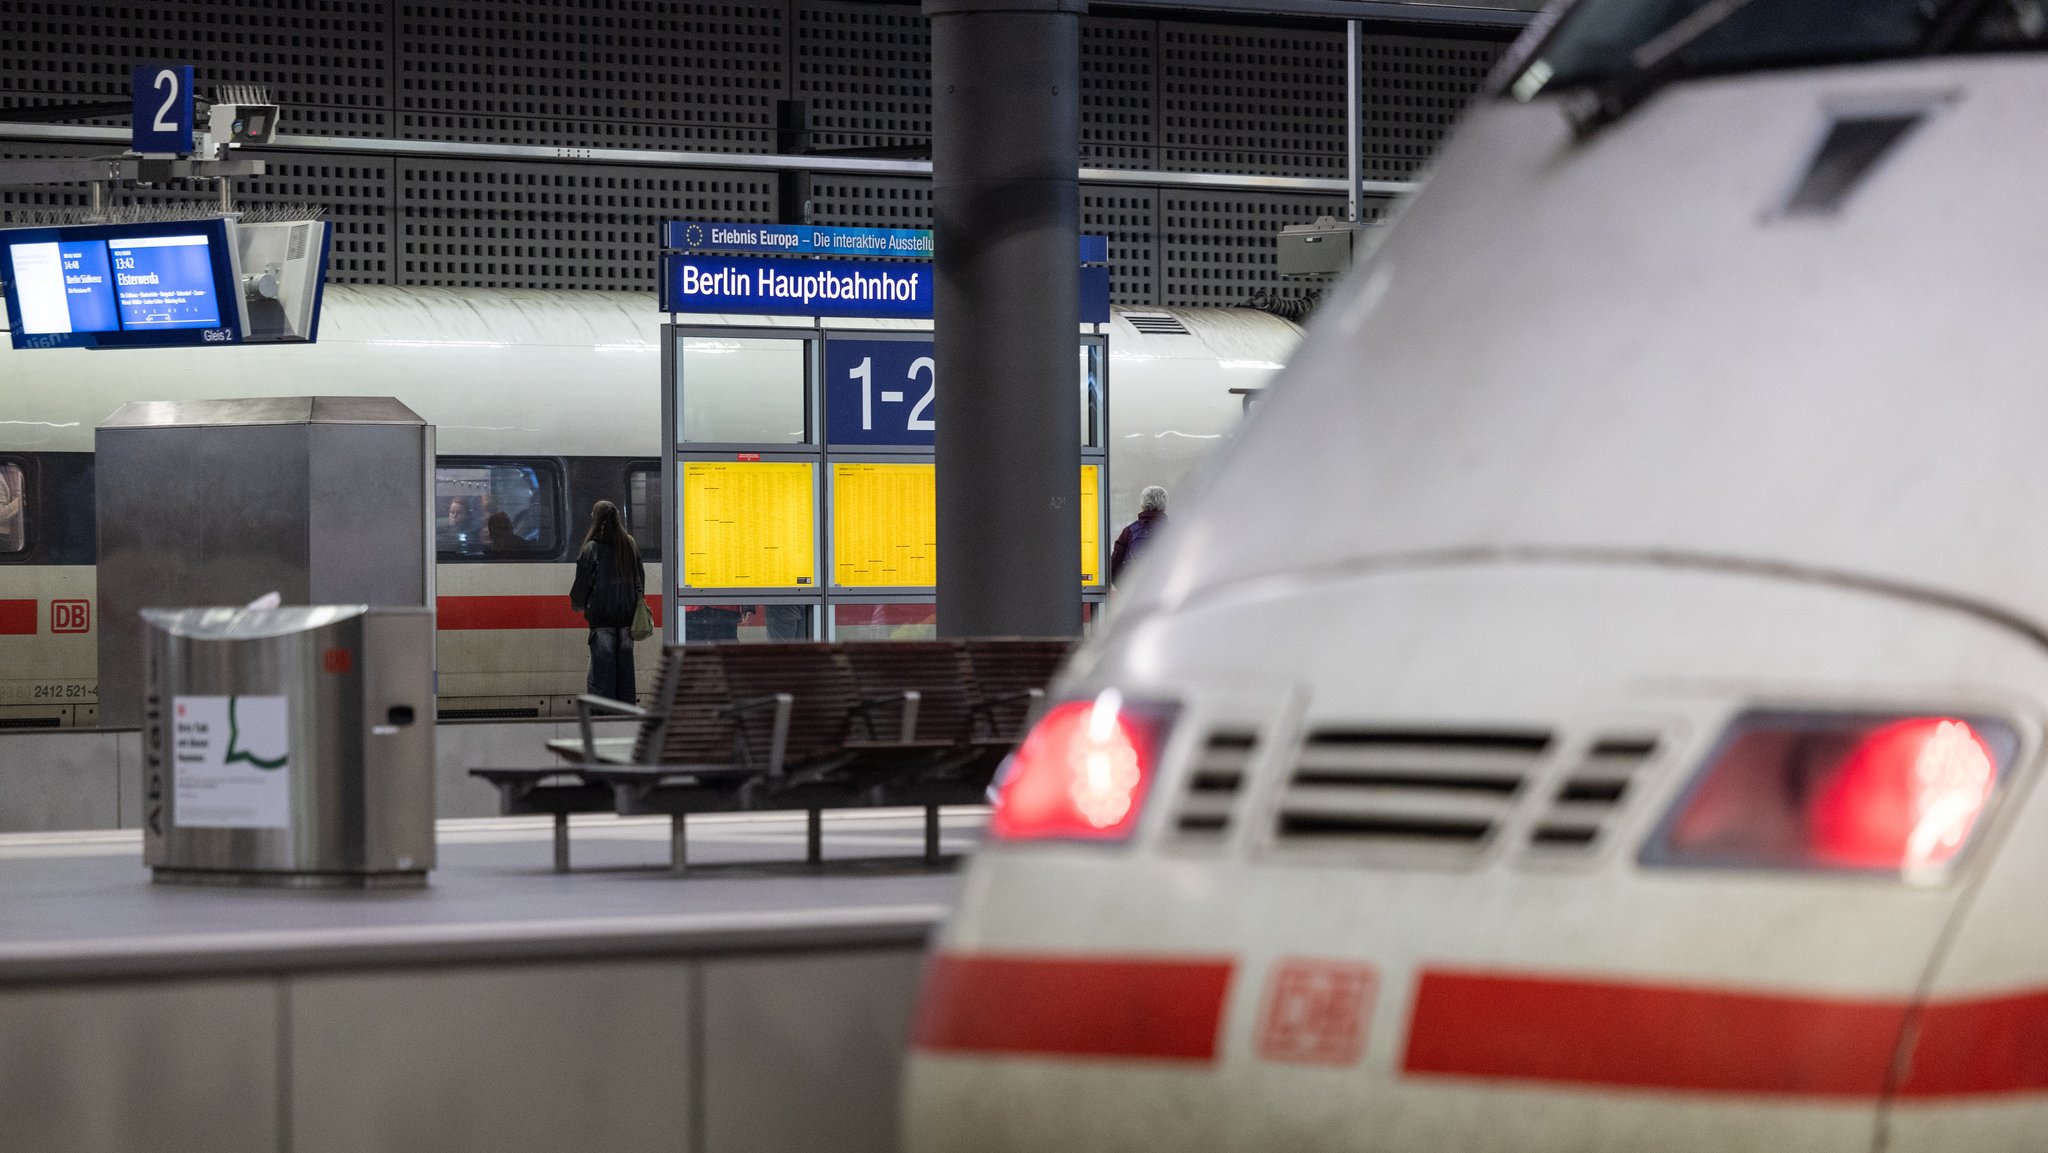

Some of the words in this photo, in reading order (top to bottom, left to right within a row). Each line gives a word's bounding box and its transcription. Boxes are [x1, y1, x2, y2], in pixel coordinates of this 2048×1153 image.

[153, 69, 178, 132] 2
[711, 228, 757, 246] Erlebnis
[760, 230, 799, 249] Europa
[813, 232, 830, 248] Die
[833, 232, 887, 250] interaktive
[115, 257, 135, 269] 13:42
[117, 272, 160, 286] Elsterwerda
[682, 265, 750, 296] Berlin
[758, 268, 918, 304] Hauptbahnhof
[204, 329, 224, 342] Gleis
[225, 329, 232, 341] 2
[849, 356, 935, 431] 1-2
[54, 603, 87, 630] DB
[34, 685, 63, 698] 2412
[1263, 963, 1374, 1059] DB
